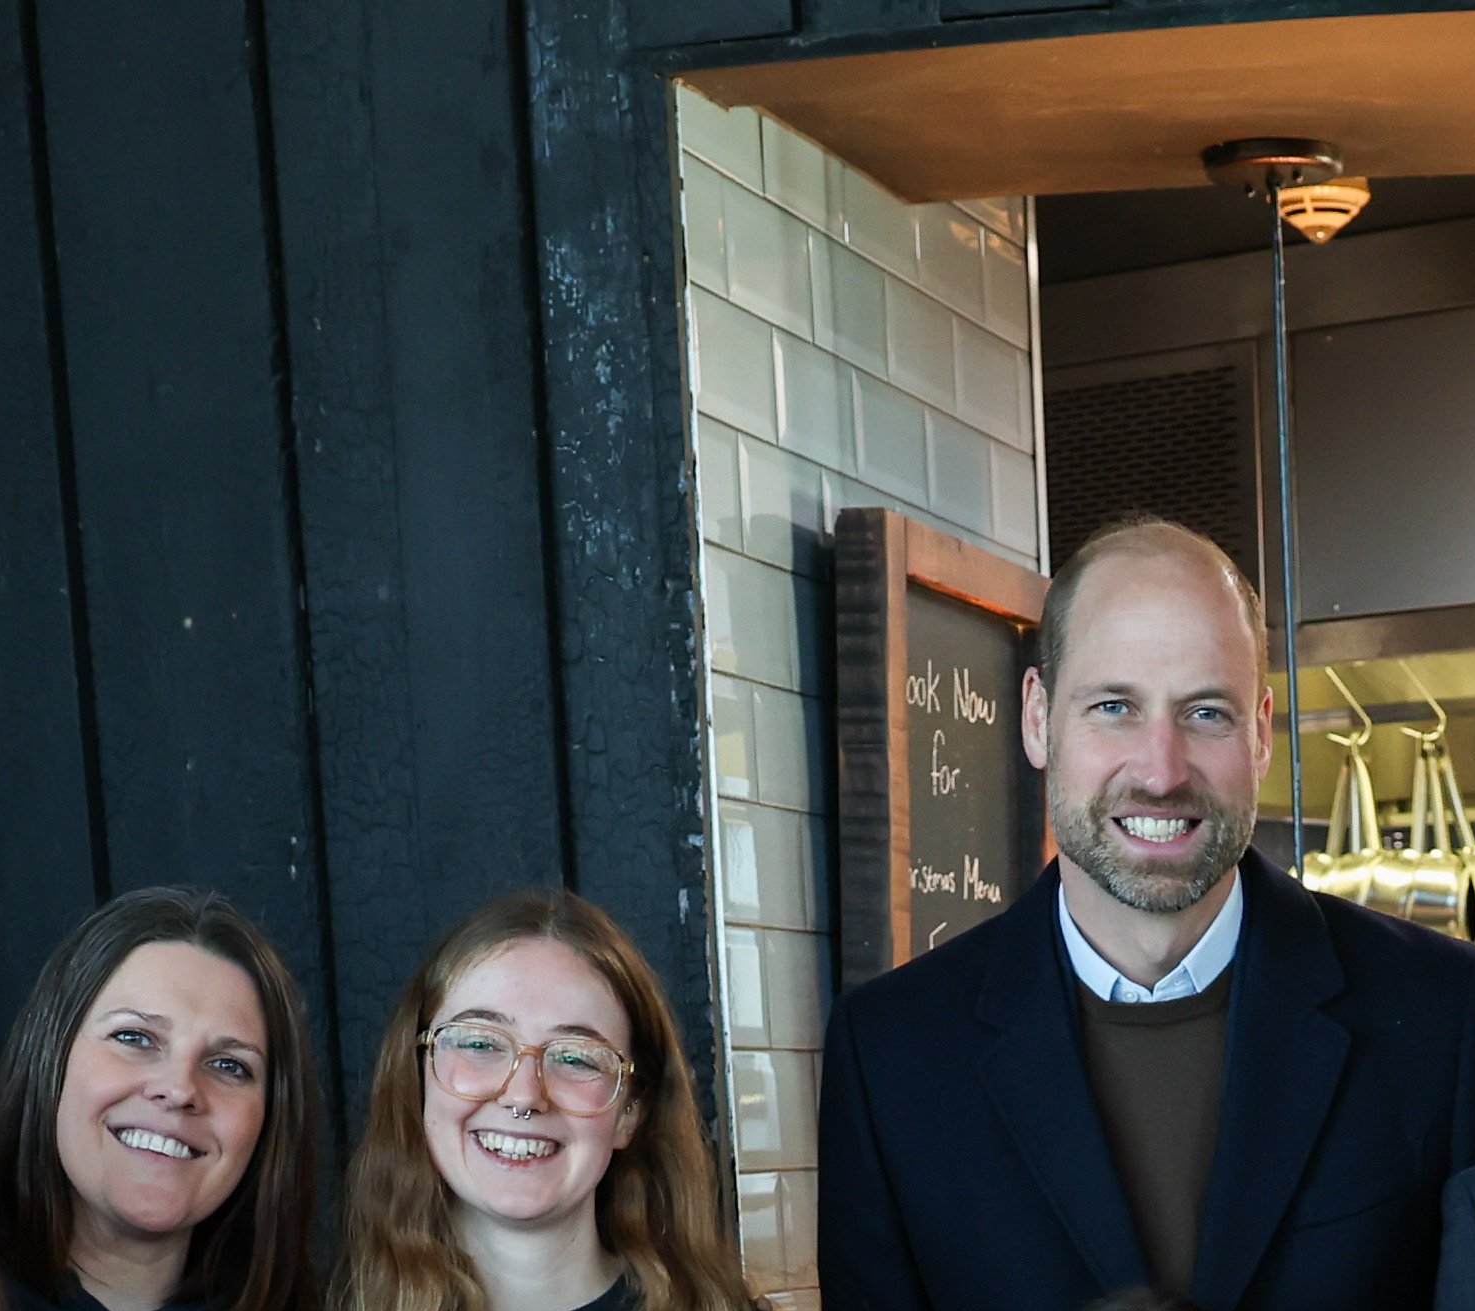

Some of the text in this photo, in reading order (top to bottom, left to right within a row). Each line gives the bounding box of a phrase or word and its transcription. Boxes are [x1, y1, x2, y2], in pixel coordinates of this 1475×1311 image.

[906, 658, 996, 726] ook Now
[930, 729, 962, 797] for
[963, 854, 1002, 903] Menu
